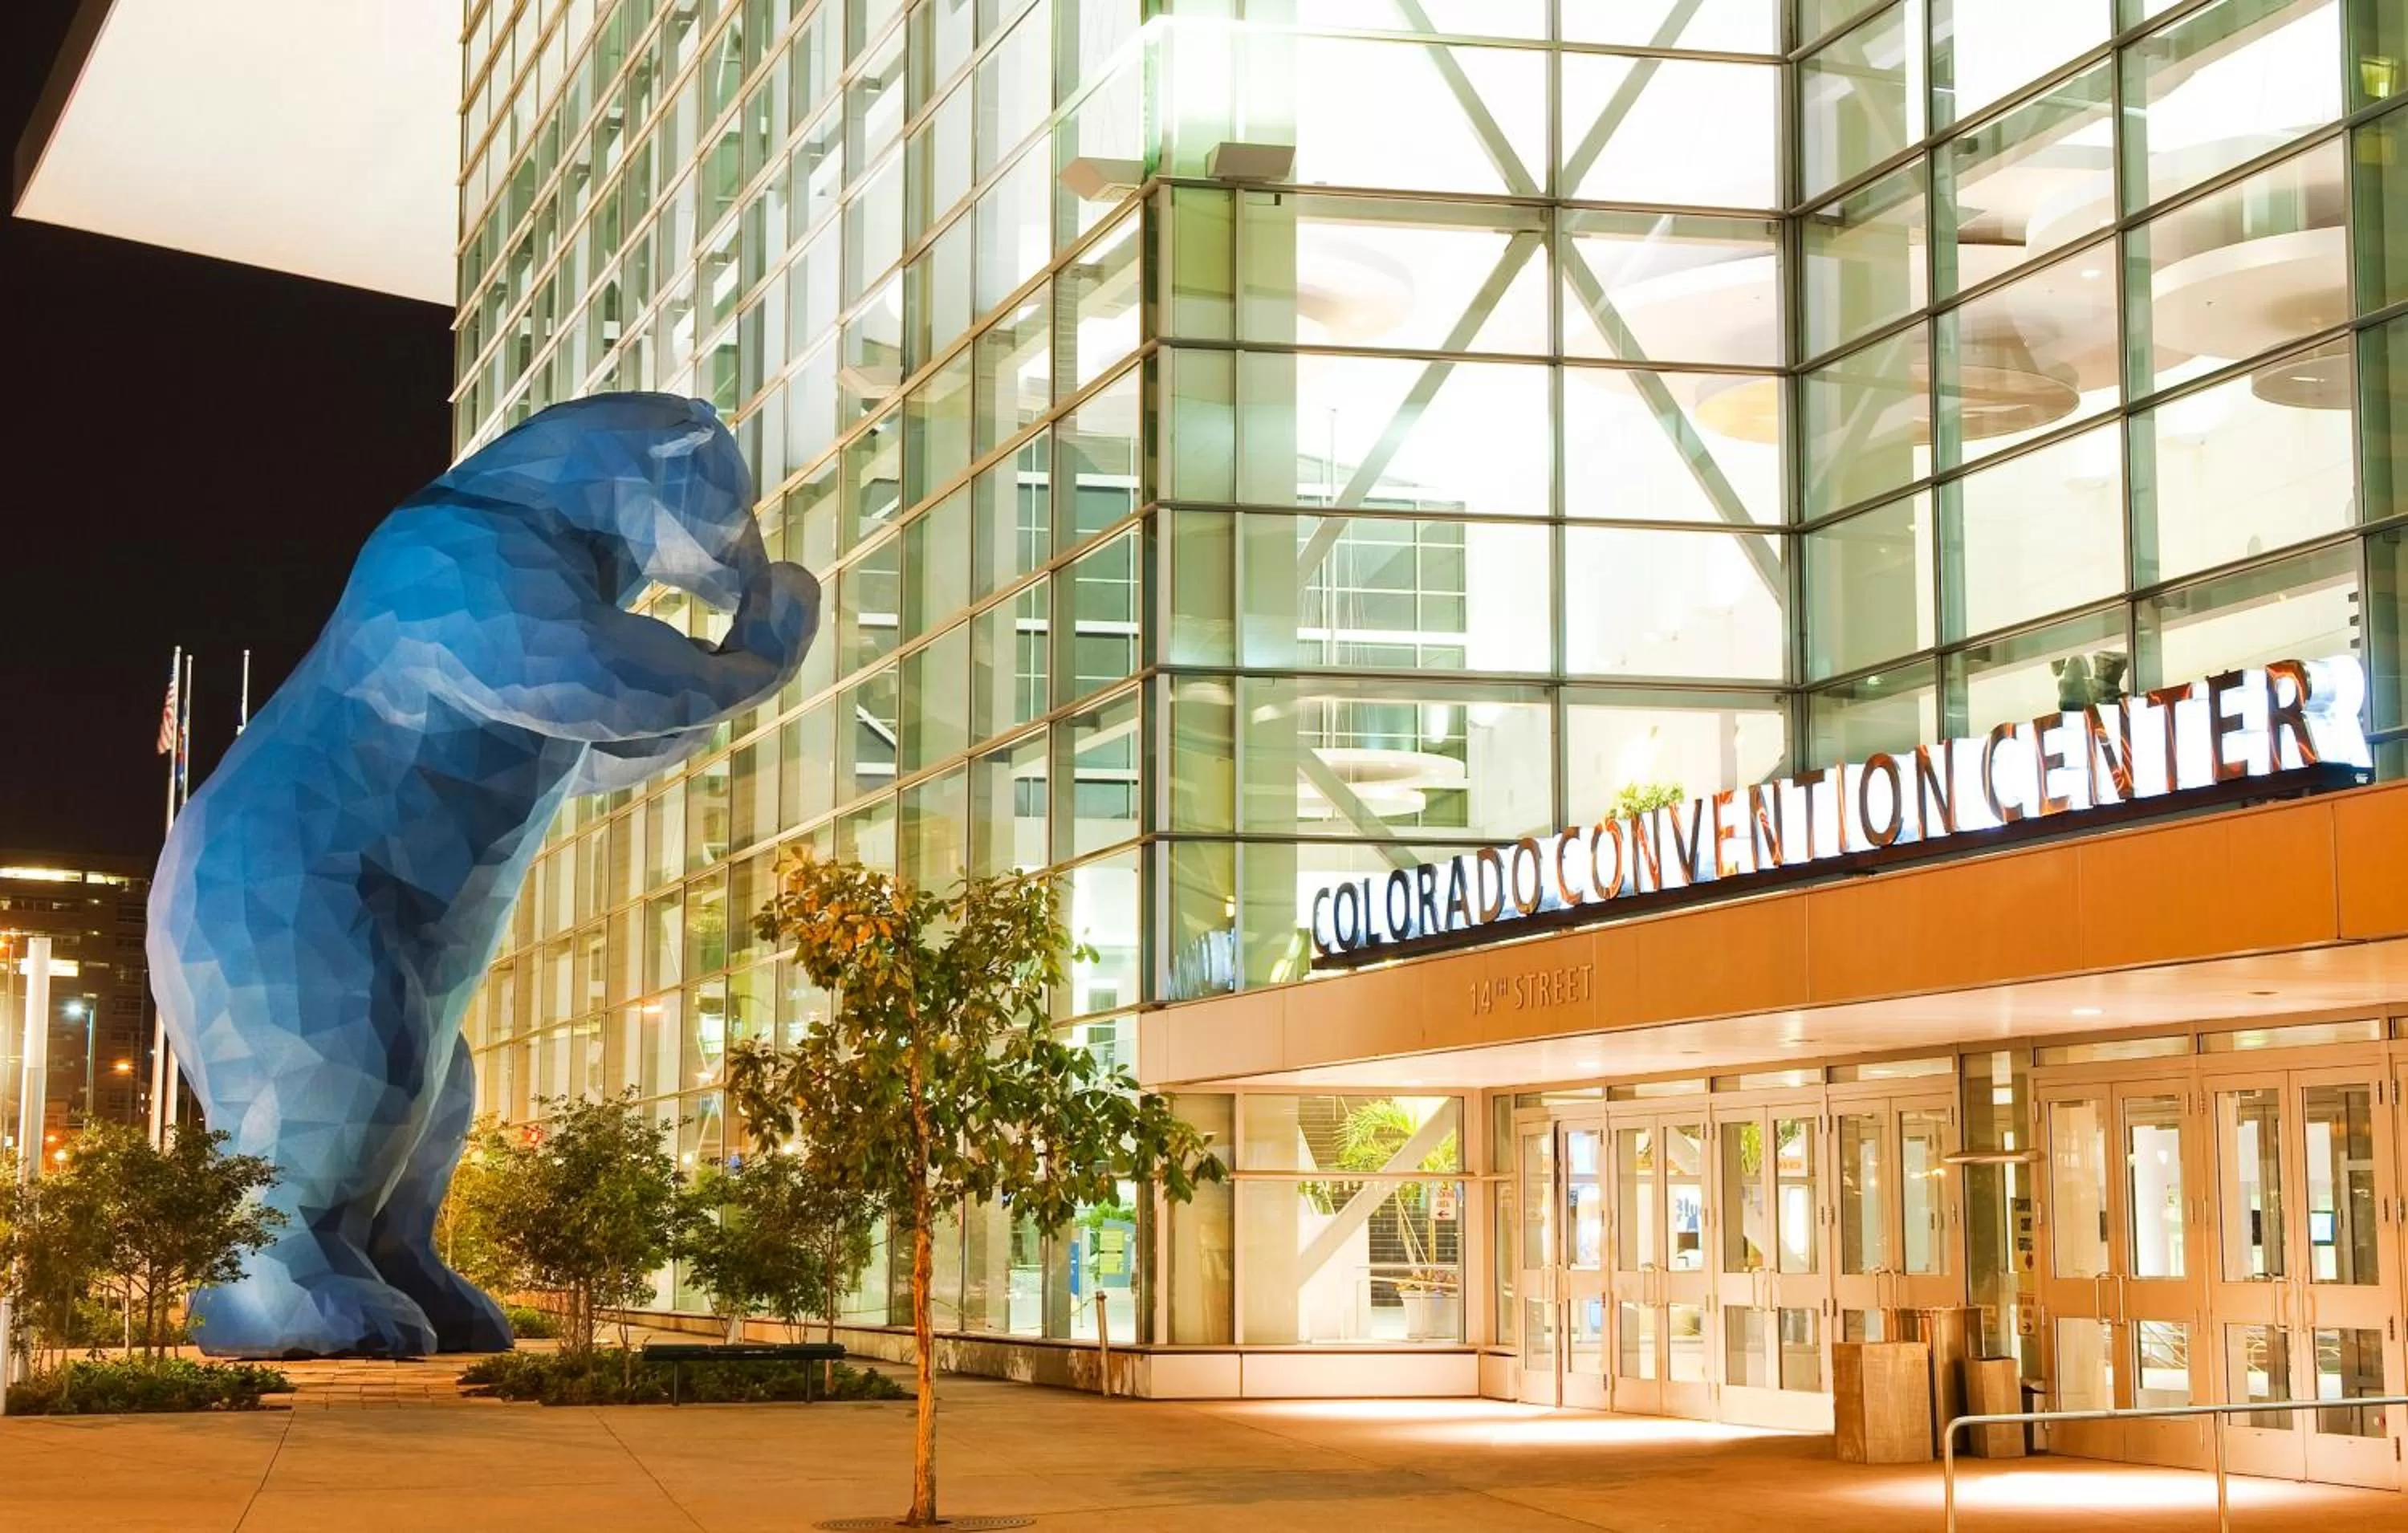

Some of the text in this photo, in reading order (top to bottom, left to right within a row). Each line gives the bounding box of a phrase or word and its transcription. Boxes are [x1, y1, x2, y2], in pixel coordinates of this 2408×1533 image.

[1312, 658, 2323, 955] COLORADO CONVENTION CENTER
[1470, 963, 1593, 1015] 14TH STREET
